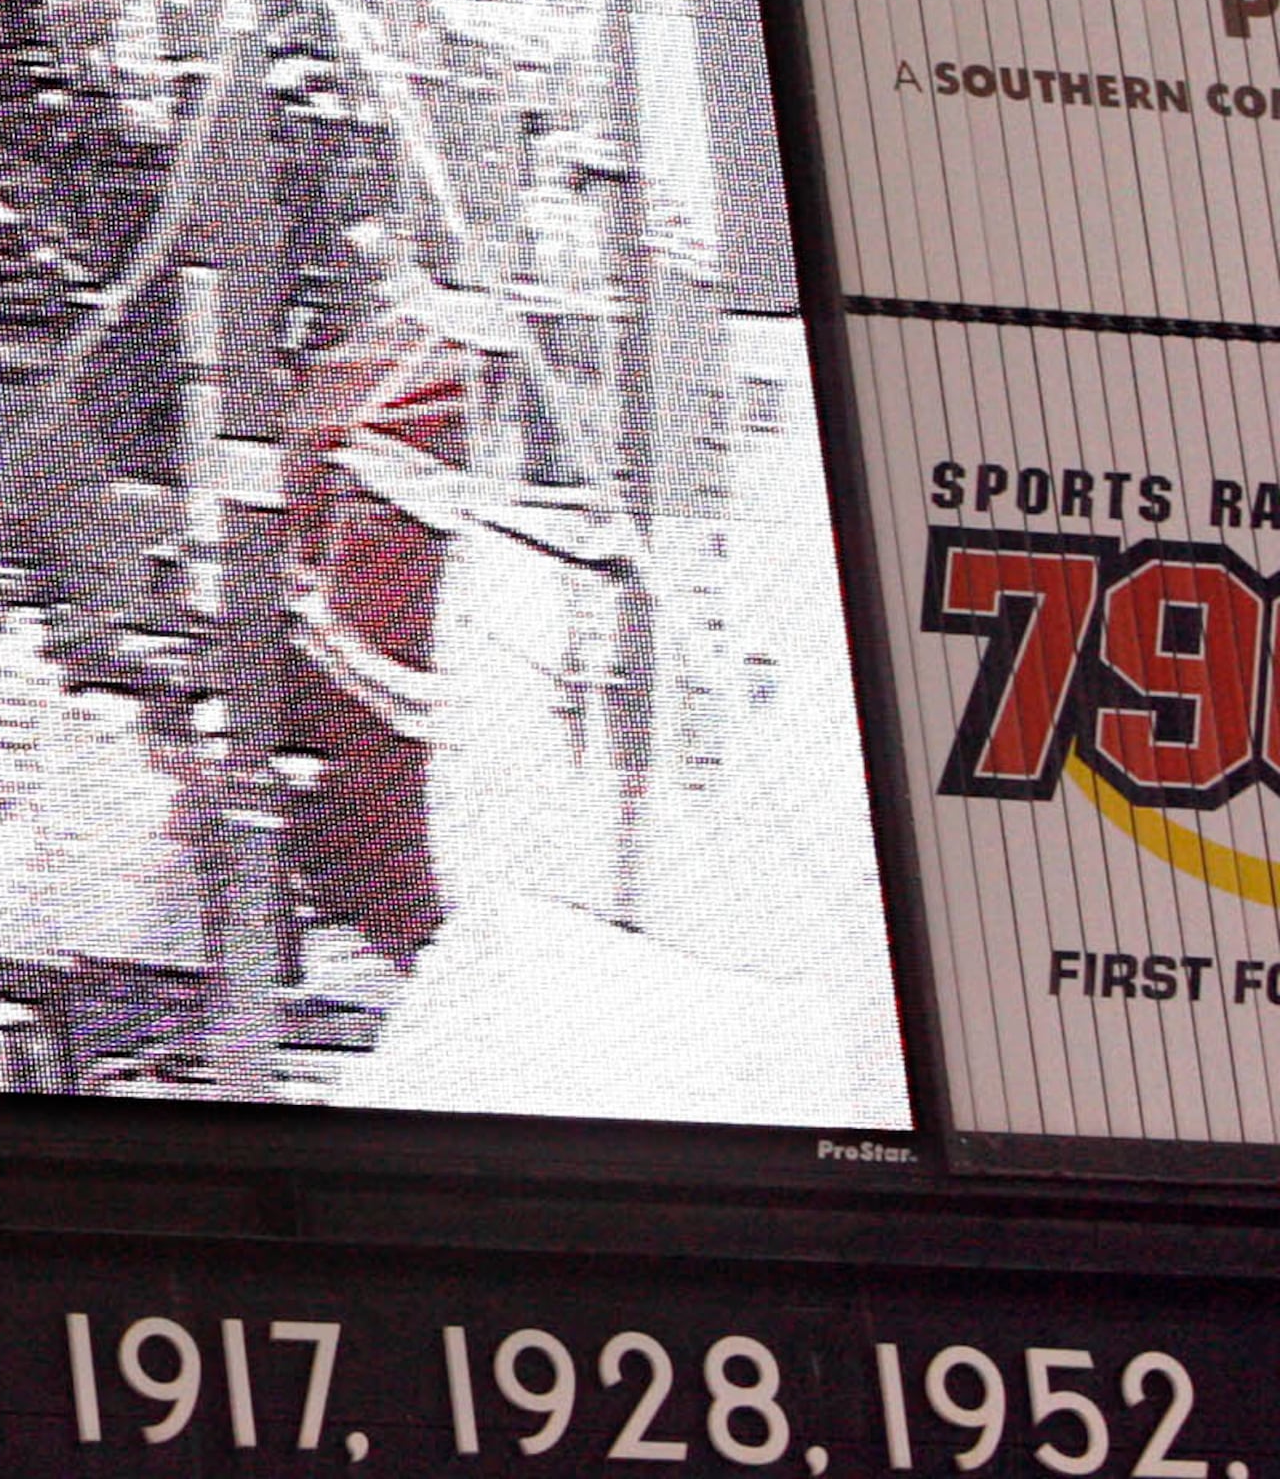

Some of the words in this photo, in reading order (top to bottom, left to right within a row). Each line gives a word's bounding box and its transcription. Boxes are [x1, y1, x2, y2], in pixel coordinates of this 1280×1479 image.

[894, 60, 922, 93] A
[935, 62, 1192, 113] SOUTHERN
[1206, 83, 1280, 119] CO
[931, 461, 1172, 523] SPORTS
[921, 525, 1280, 811] 79
[1048, 950, 1213, 1001] FIRST
[66, 1312, 370, 1464] 1917,
[443, 1325, 829, 1476] 1928,
